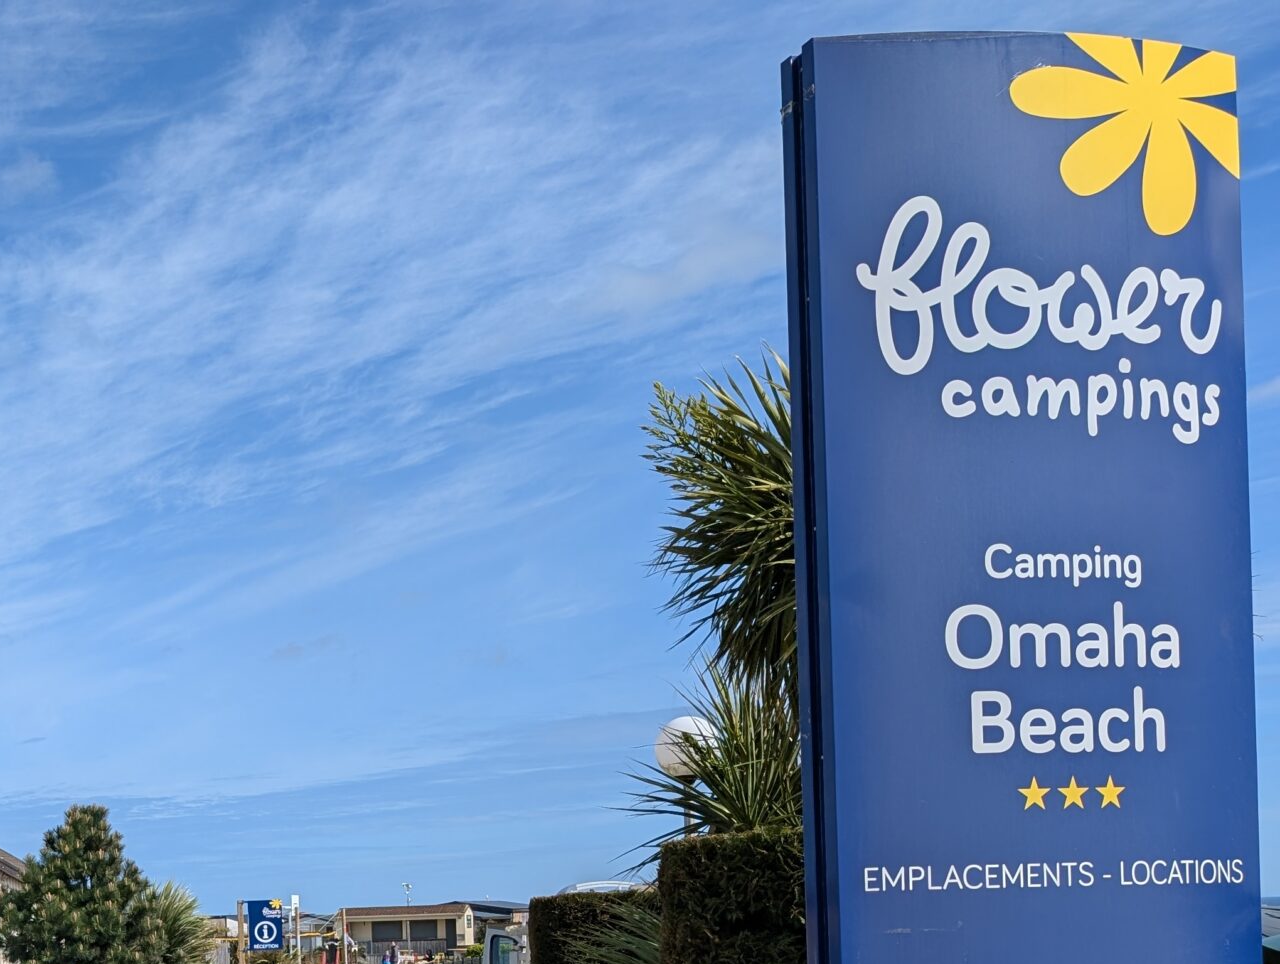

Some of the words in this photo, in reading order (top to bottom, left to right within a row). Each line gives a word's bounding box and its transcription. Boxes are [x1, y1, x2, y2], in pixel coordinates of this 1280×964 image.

[856, 195, 1222, 376] flower
[941, 358, 1221, 445] campings
[984, 543, 1142, 588] Camping
[944, 601, 1181, 670] Omaha
[970, 686, 1167, 755] Beach
[864, 861, 1095, 892] EMPLACEMENTS
[1119, 859, 1245, 886] LOCATIONS
